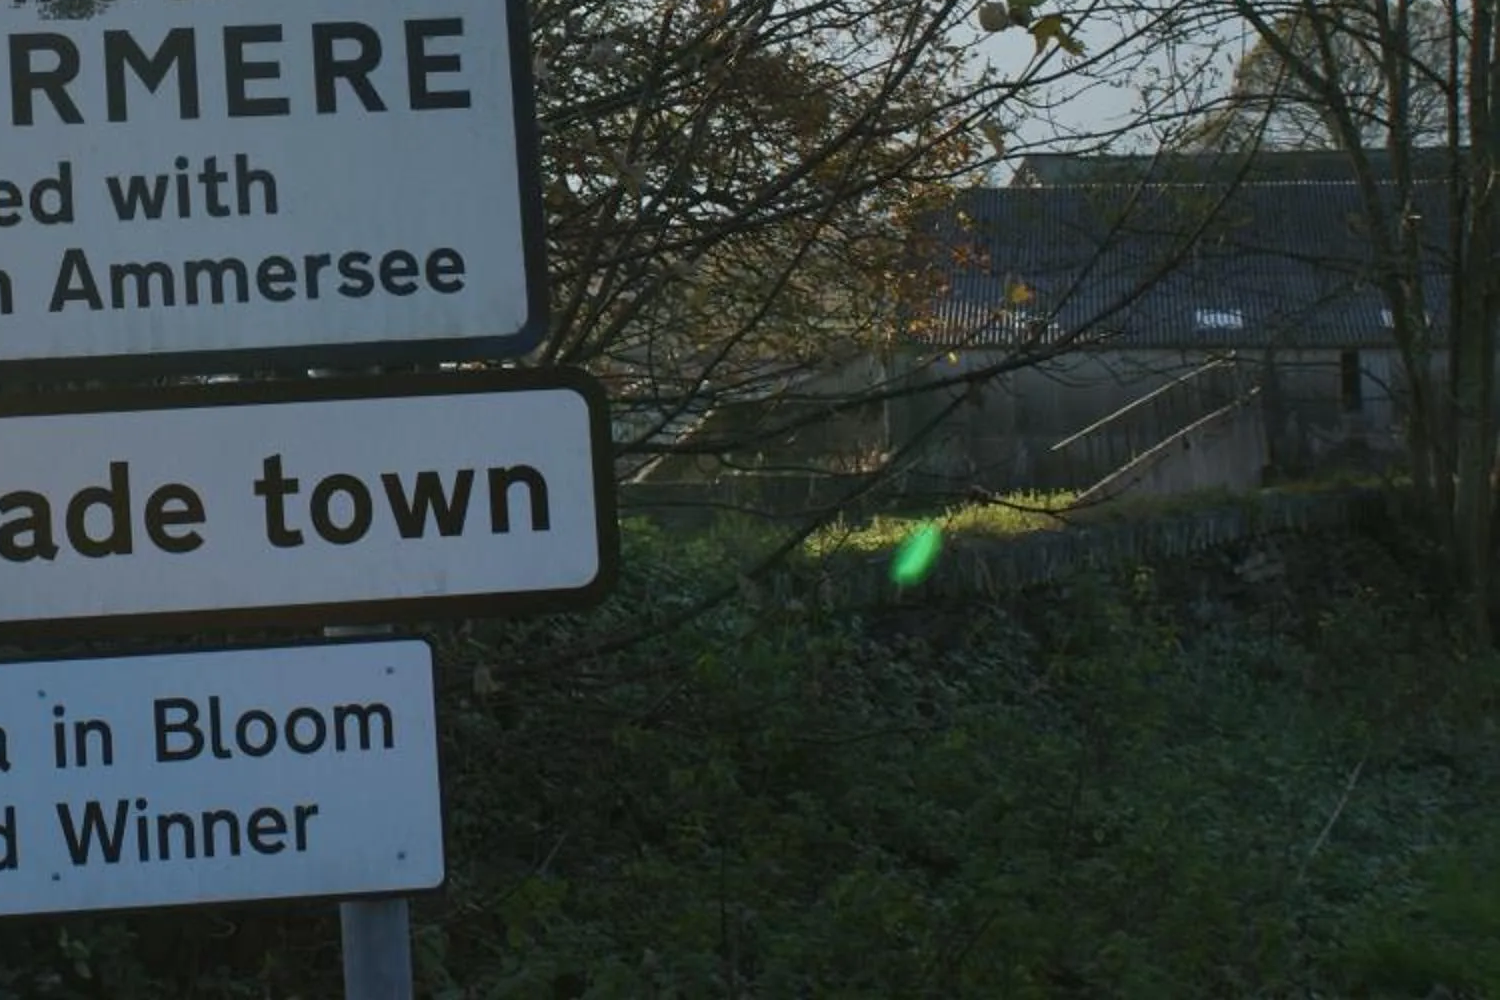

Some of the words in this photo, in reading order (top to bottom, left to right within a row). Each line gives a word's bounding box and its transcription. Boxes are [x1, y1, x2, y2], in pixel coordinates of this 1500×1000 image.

[105, 153, 278, 222] with
[49, 245, 467, 314] Ammersee
[253, 453, 551, 548] town
[53, 705, 113, 769] in
[152, 694, 396, 763] Bloom
[56, 797, 319, 867] Winner
